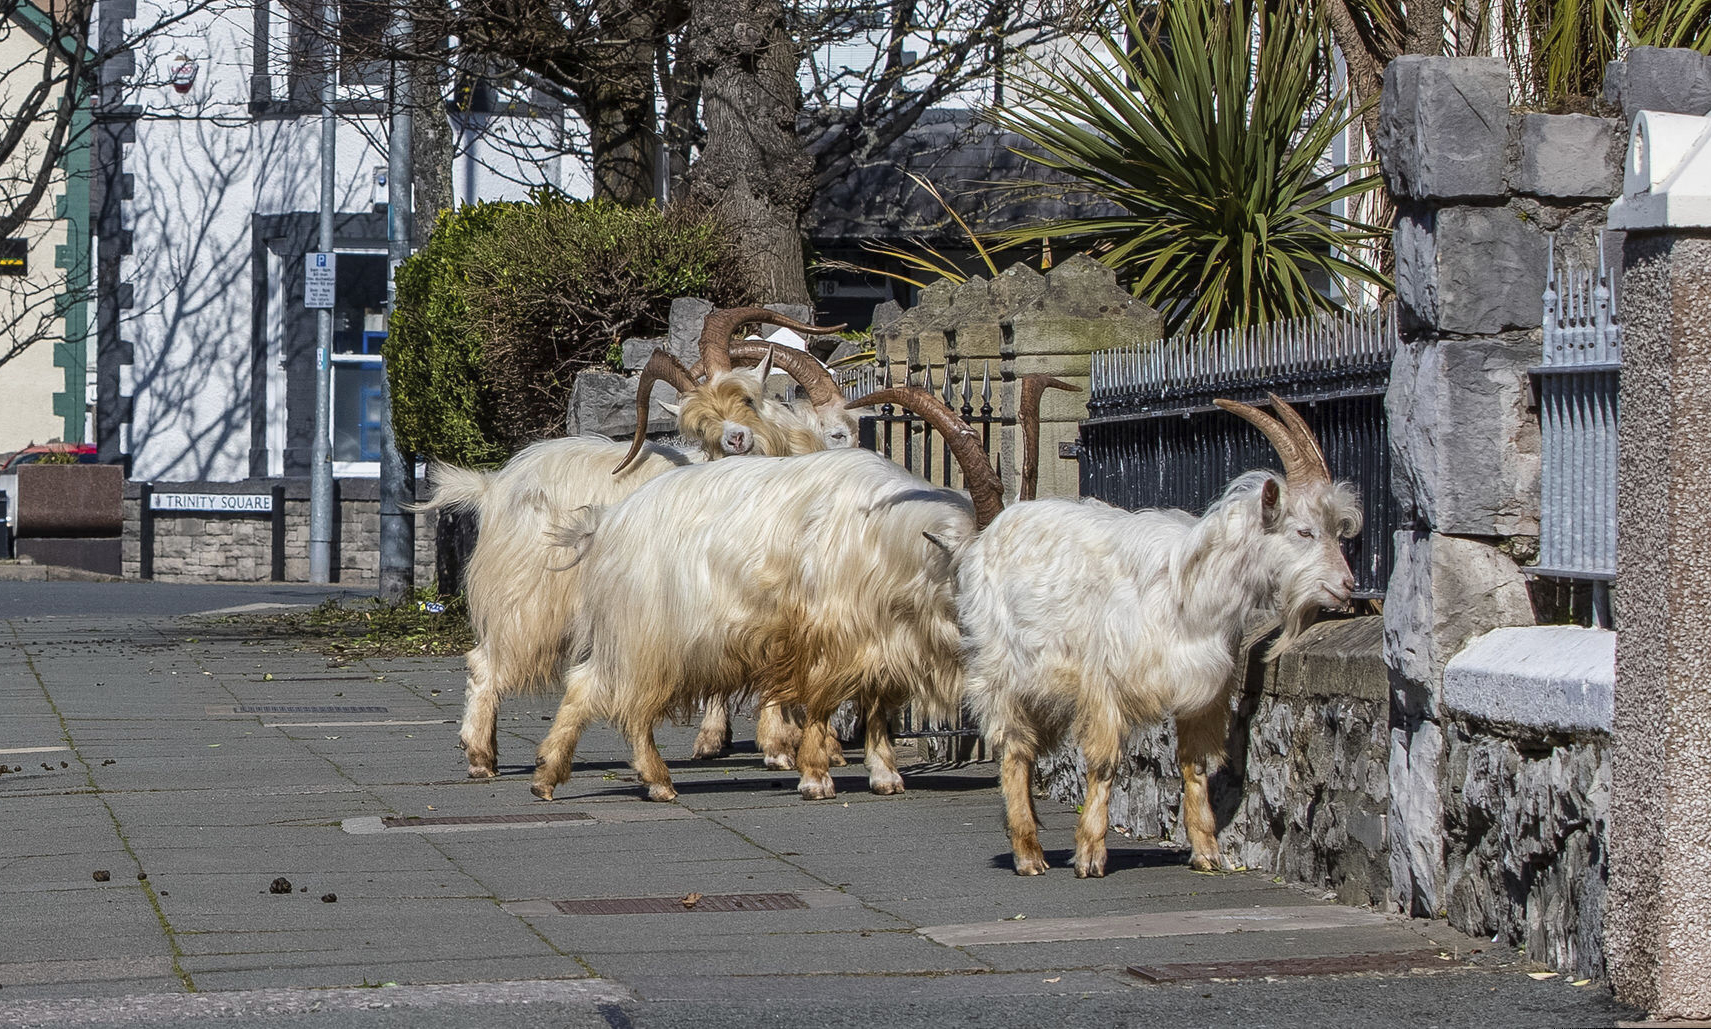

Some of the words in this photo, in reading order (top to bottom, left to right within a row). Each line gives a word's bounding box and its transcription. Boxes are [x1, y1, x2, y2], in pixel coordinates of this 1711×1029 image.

[822, 282, 835, 295] 18
[166, 495, 216, 509] TRINITY
[221, 496, 271, 509] SQUARE
